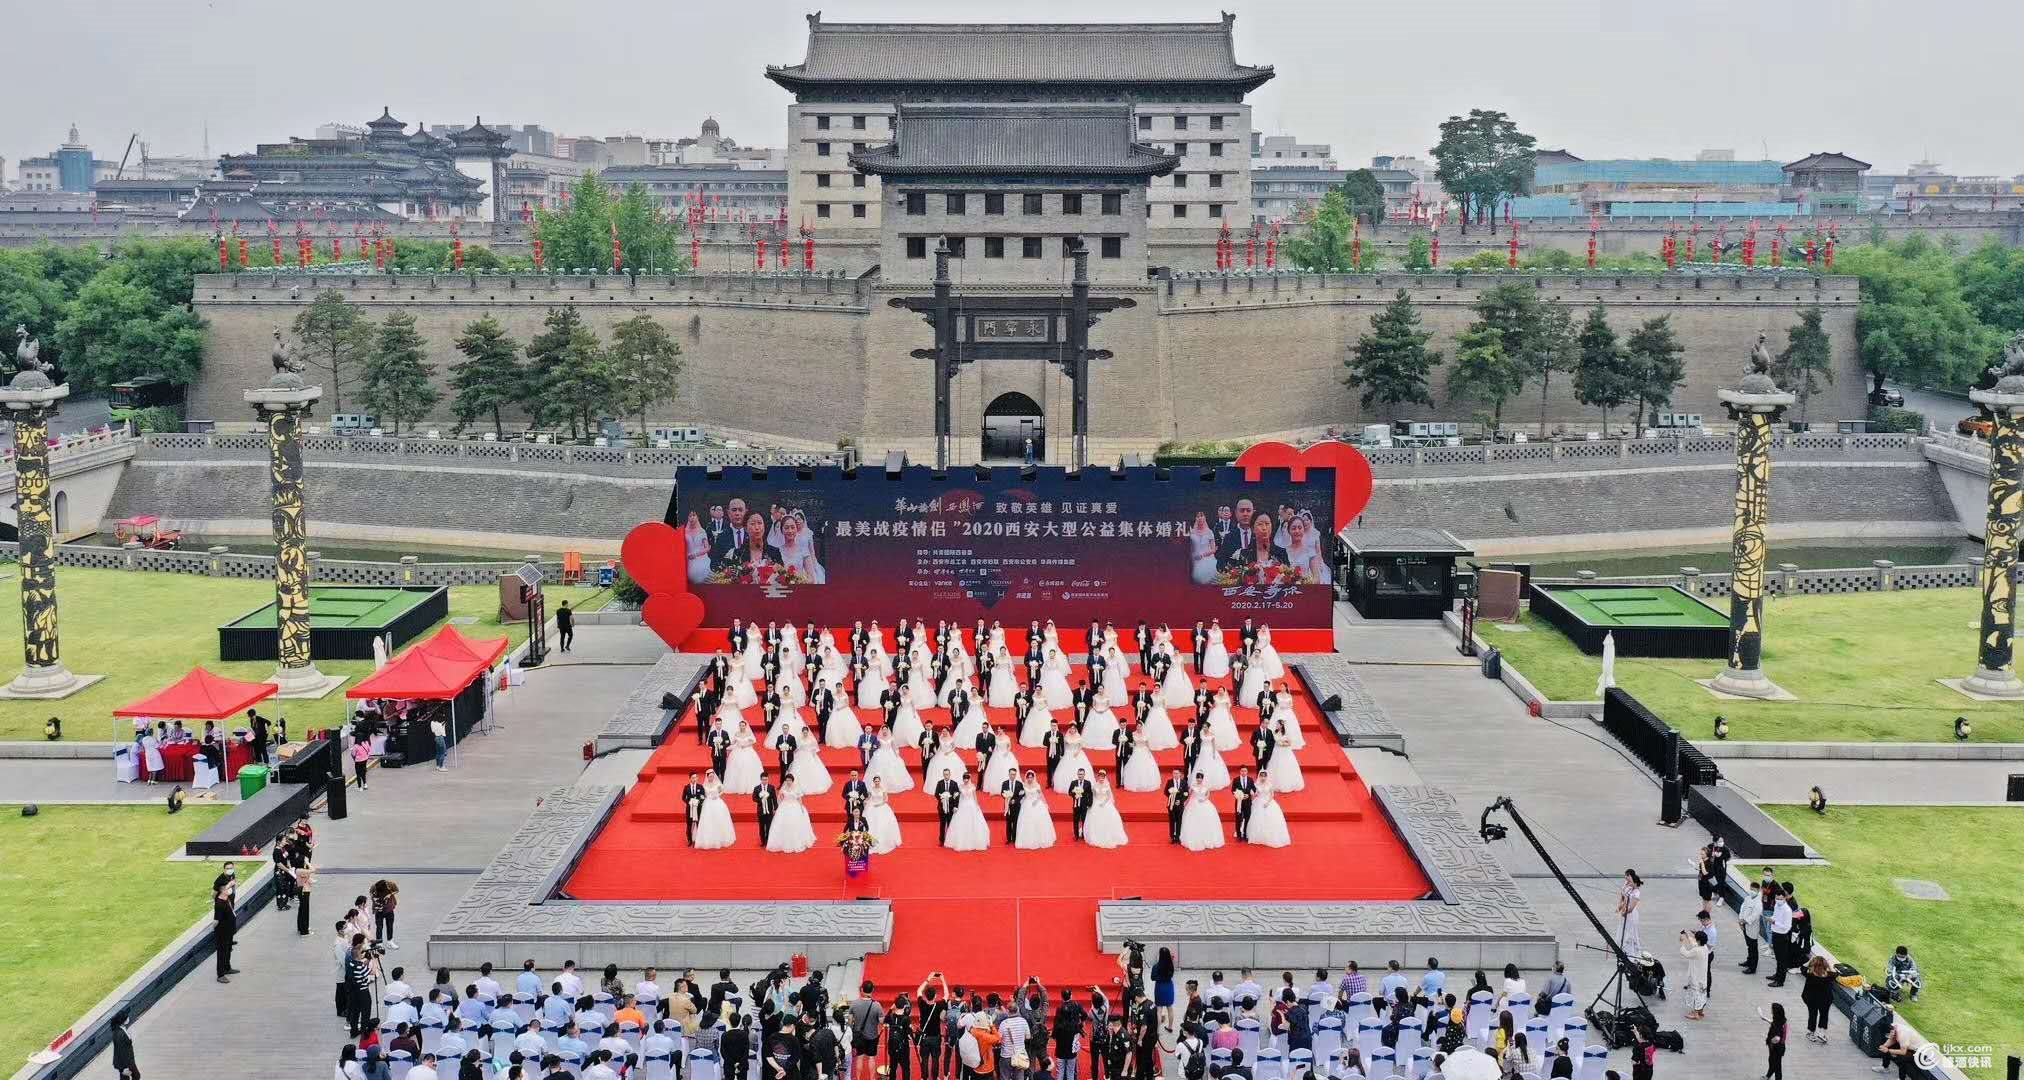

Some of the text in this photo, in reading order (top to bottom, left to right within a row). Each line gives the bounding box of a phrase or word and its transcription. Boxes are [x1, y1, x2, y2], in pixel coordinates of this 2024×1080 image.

[995, 502, 1118, 514] 致敬英雄 见证真爱
[1231, 601, 1294, 609] 2020.2.17-5.20
